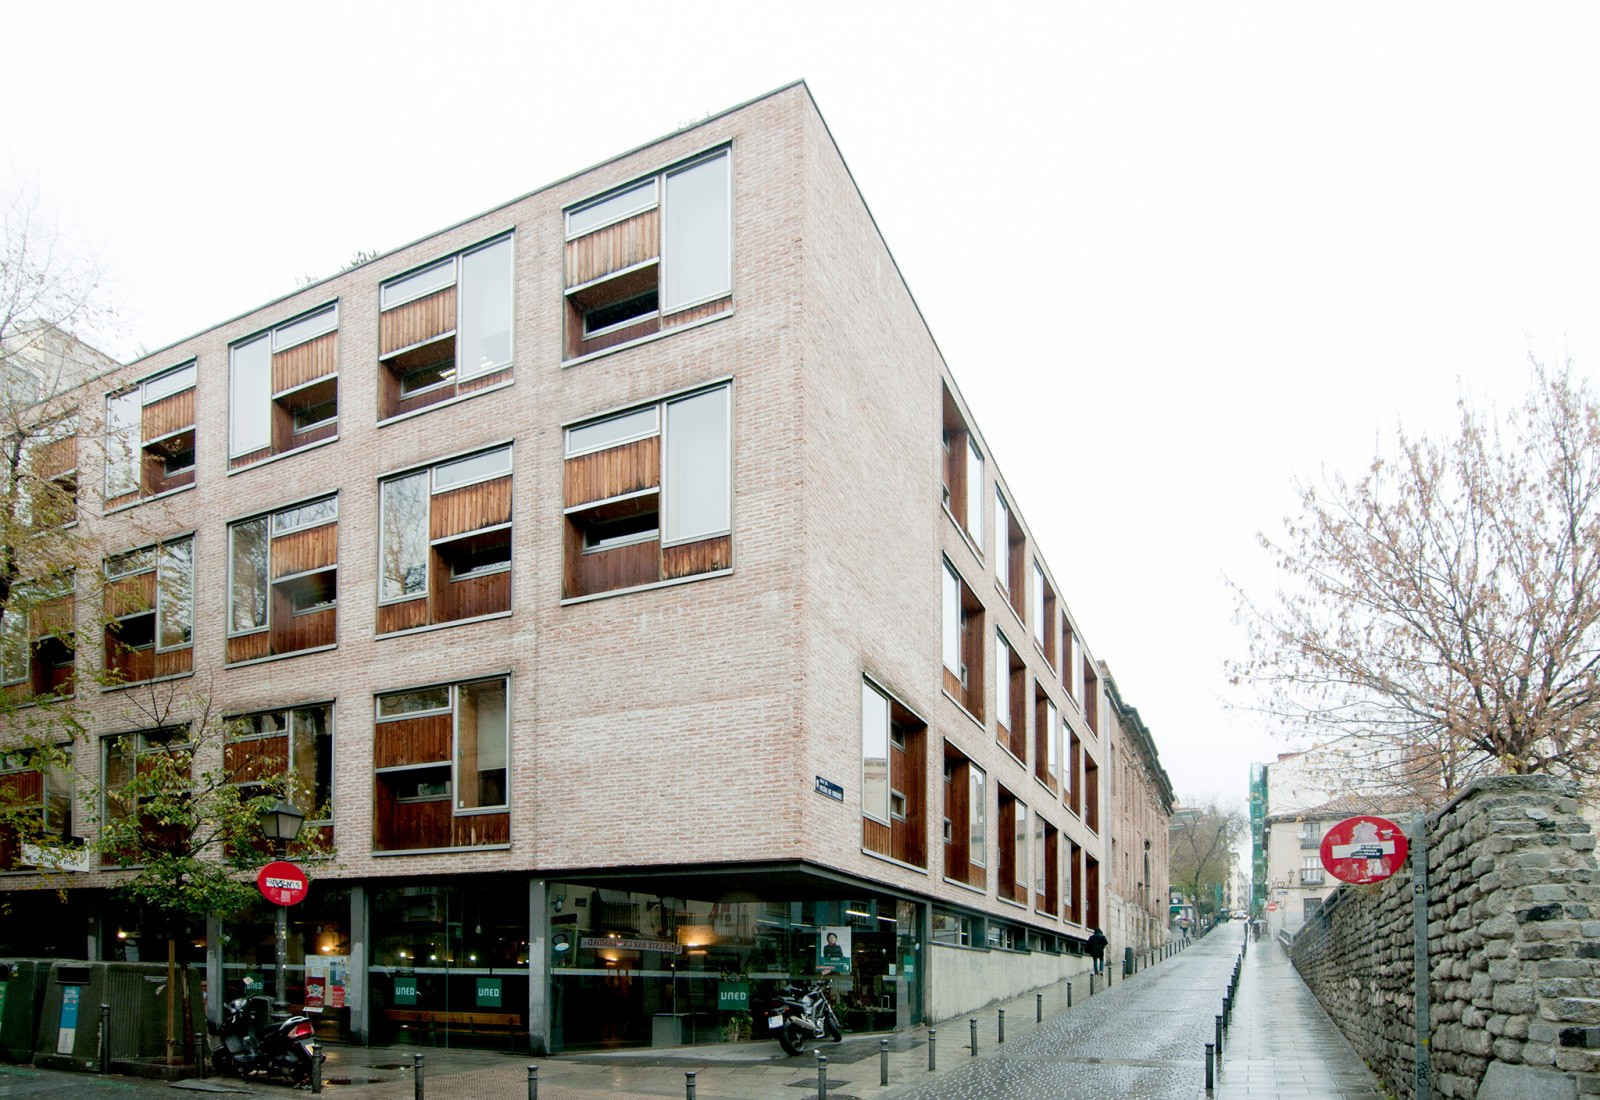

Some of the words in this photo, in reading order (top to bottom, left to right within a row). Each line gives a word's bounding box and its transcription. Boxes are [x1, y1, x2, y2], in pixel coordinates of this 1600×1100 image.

[395, 986, 415, 996] UNED
[478, 987, 500, 997] UNED
[720, 991, 747, 1001] UNED
